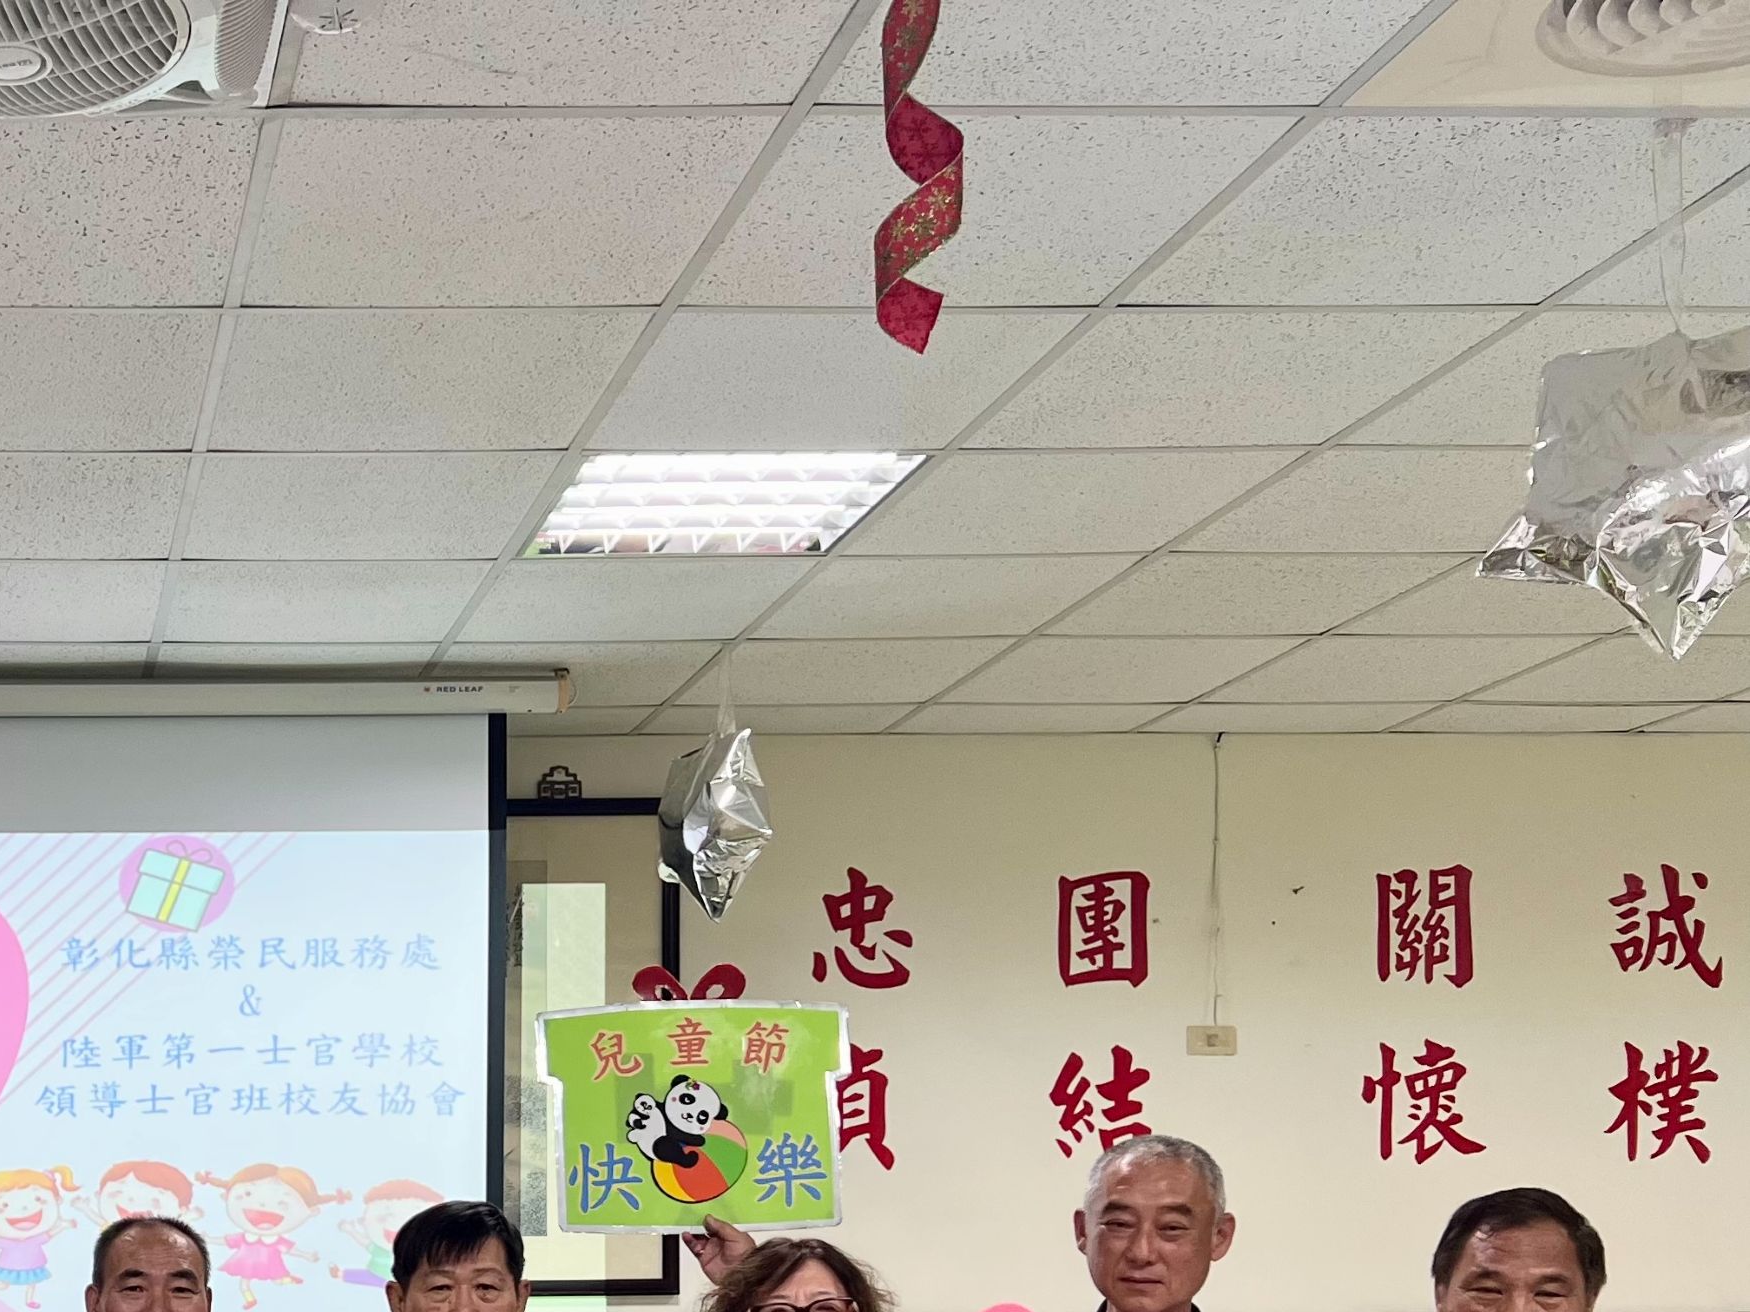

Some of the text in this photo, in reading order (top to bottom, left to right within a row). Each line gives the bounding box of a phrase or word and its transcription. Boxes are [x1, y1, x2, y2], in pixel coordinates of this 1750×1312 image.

[458, 685, 484, 693] LEAF
[59, 932, 443, 973] 彰化縣榮民服務處
[237, 984, 262, 1017] &
[1050, 870, 1152, 1158] 團結
[1361, 864, 1487, 1165] 關懷
[1603, 863, 1724, 1164] 誠樸
[60, 1031, 445, 1072] 陸軍第一士官學校
[593, 1016, 790, 1081] 兒童節
[35, 1080, 466, 1119] 領導士官班校友協會
